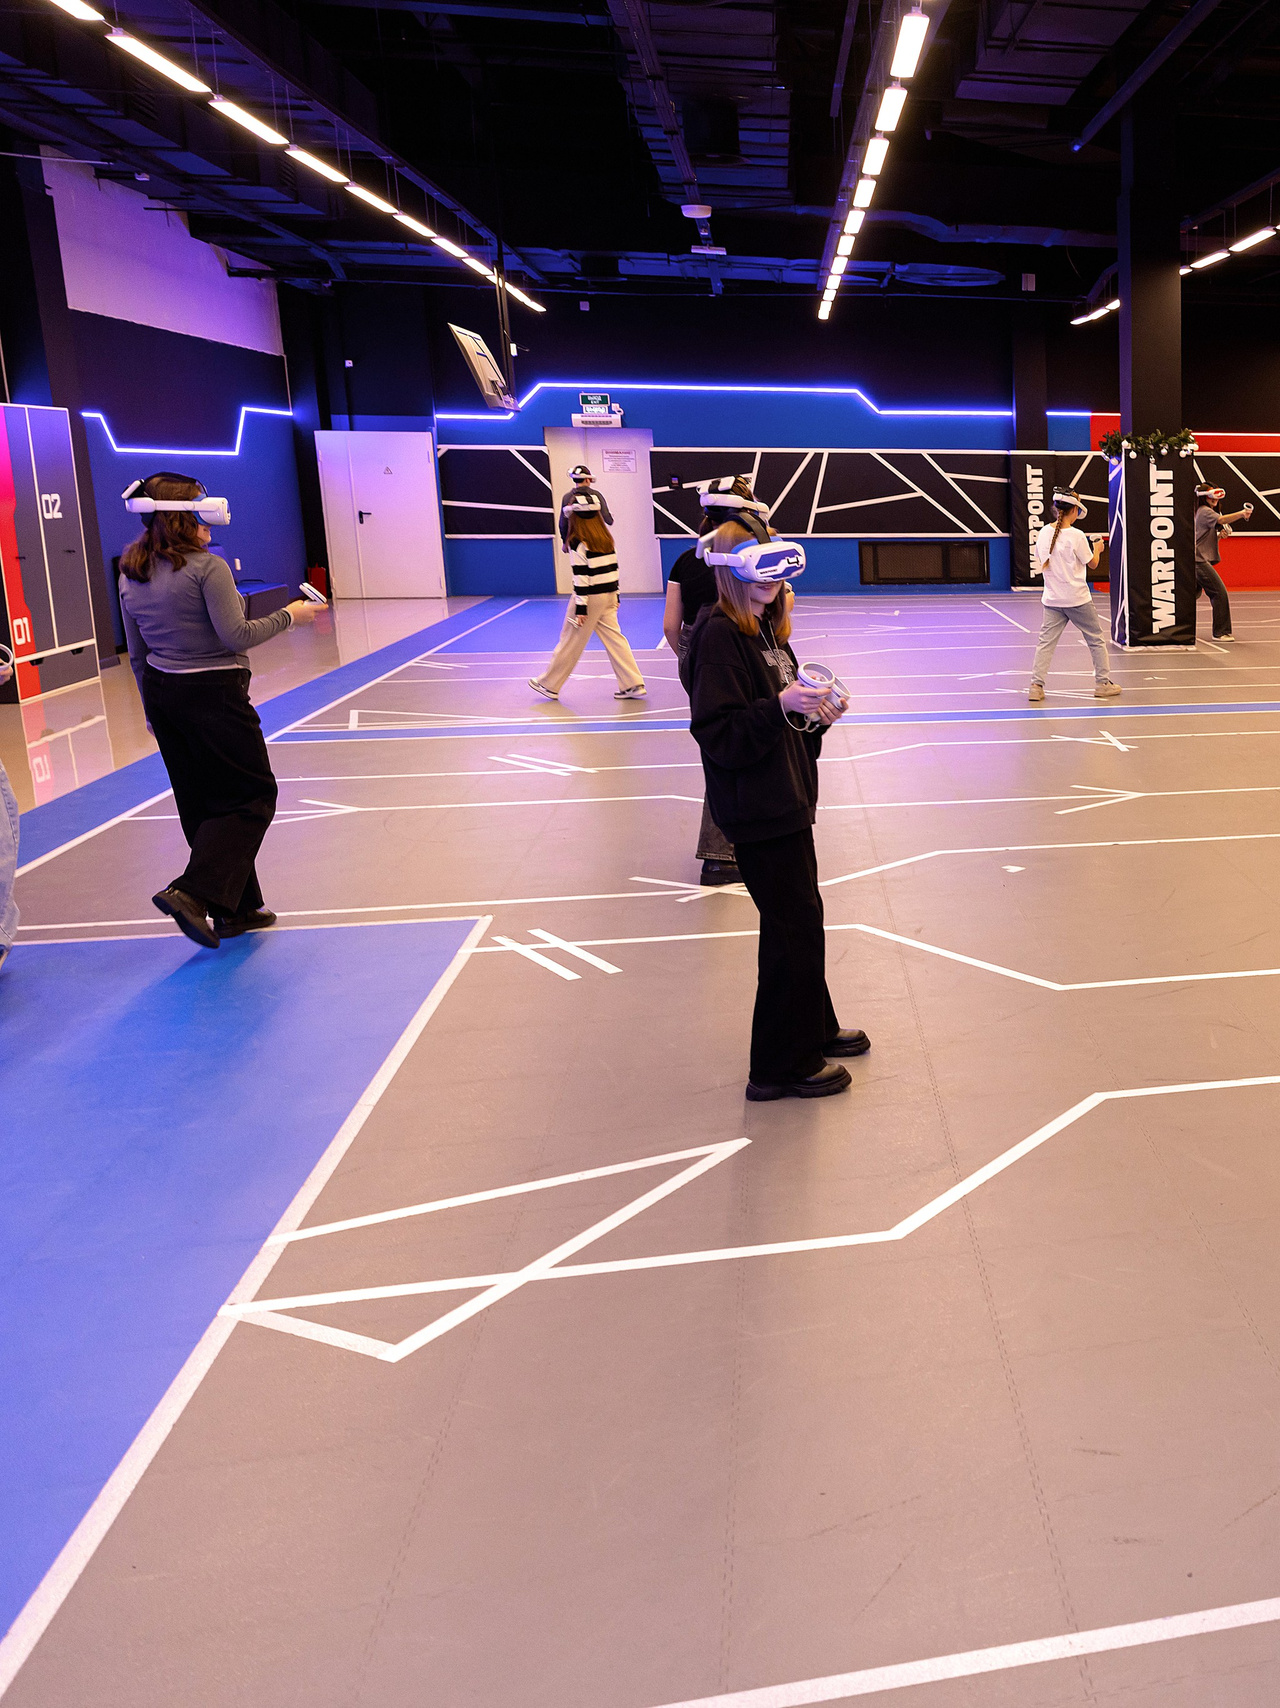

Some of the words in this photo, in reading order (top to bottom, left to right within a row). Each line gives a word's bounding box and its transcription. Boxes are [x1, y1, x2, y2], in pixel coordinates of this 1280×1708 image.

[41, 493, 62, 519] 02
[786, 556, 800, 566] 4
[1150, 463, 1176, 634] WARPOINT
[12, 617, 31, 645] 01
